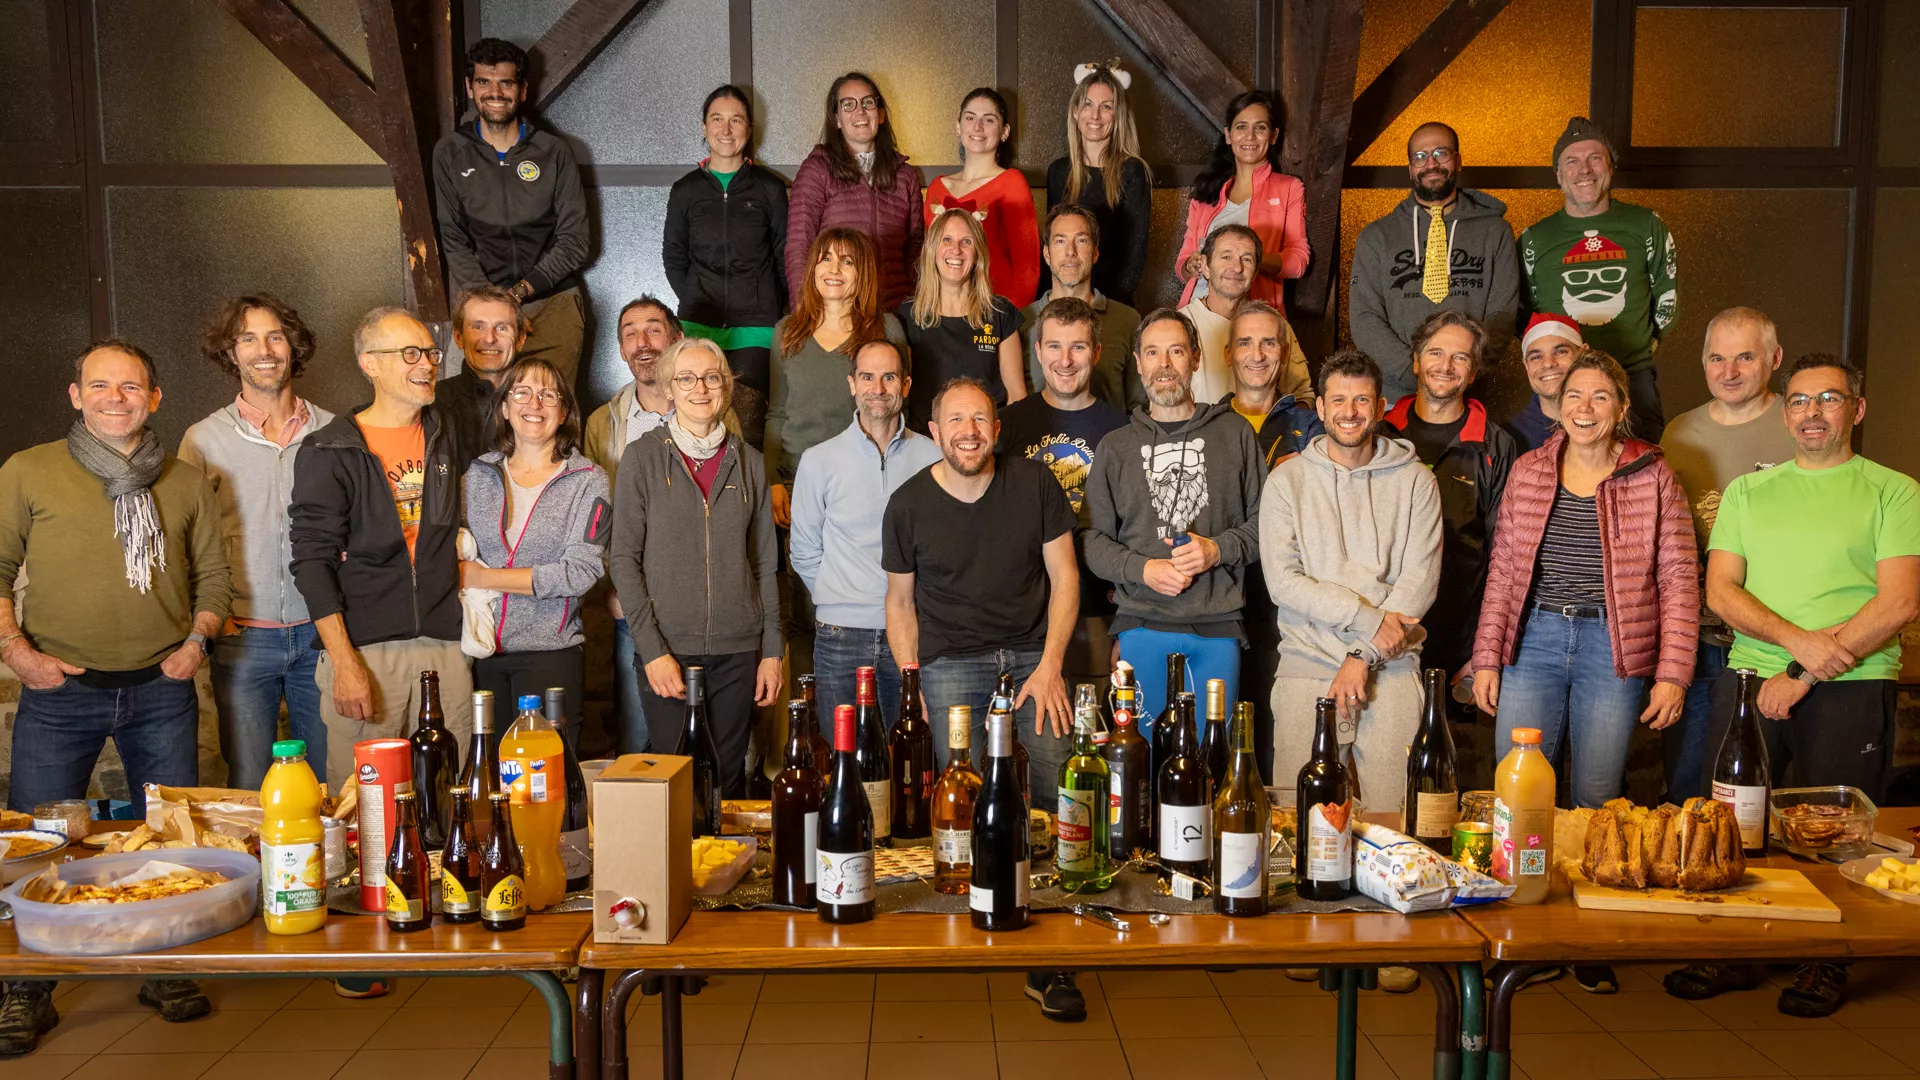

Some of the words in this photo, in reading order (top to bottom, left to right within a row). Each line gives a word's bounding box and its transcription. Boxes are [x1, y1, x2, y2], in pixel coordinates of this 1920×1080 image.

[1025, 445, 1041, 460] La
[1040, 433, 1070, 448] Folie
[388, 459, 423, 483] OXBO
[1182, 825, 1203, 844] 12
[499, 887, 523, 907] Leffe
